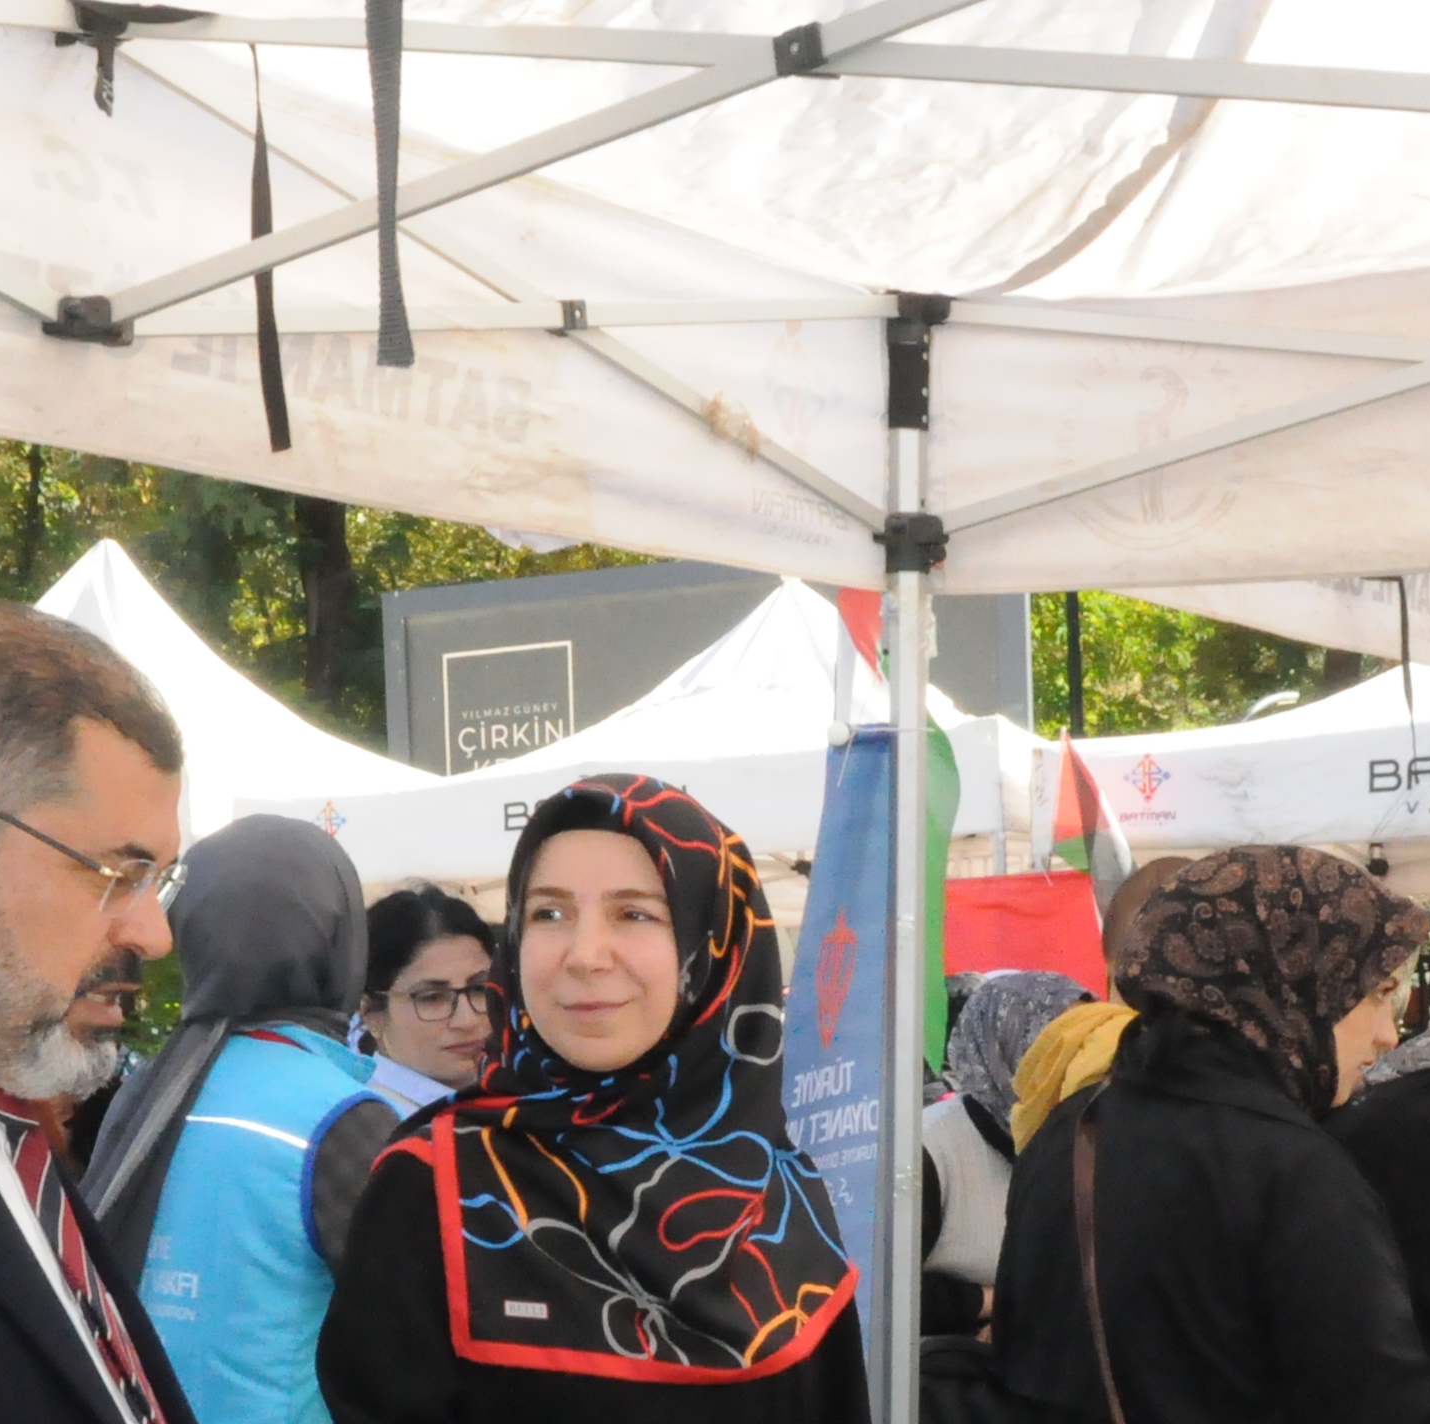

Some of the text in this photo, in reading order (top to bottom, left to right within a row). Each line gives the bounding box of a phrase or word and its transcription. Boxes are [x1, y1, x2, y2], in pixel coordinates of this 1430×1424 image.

[461, 700, 559, 721] YILMAZ GÜNEY
[457, 714, 564, 760] ÇİRKİN
